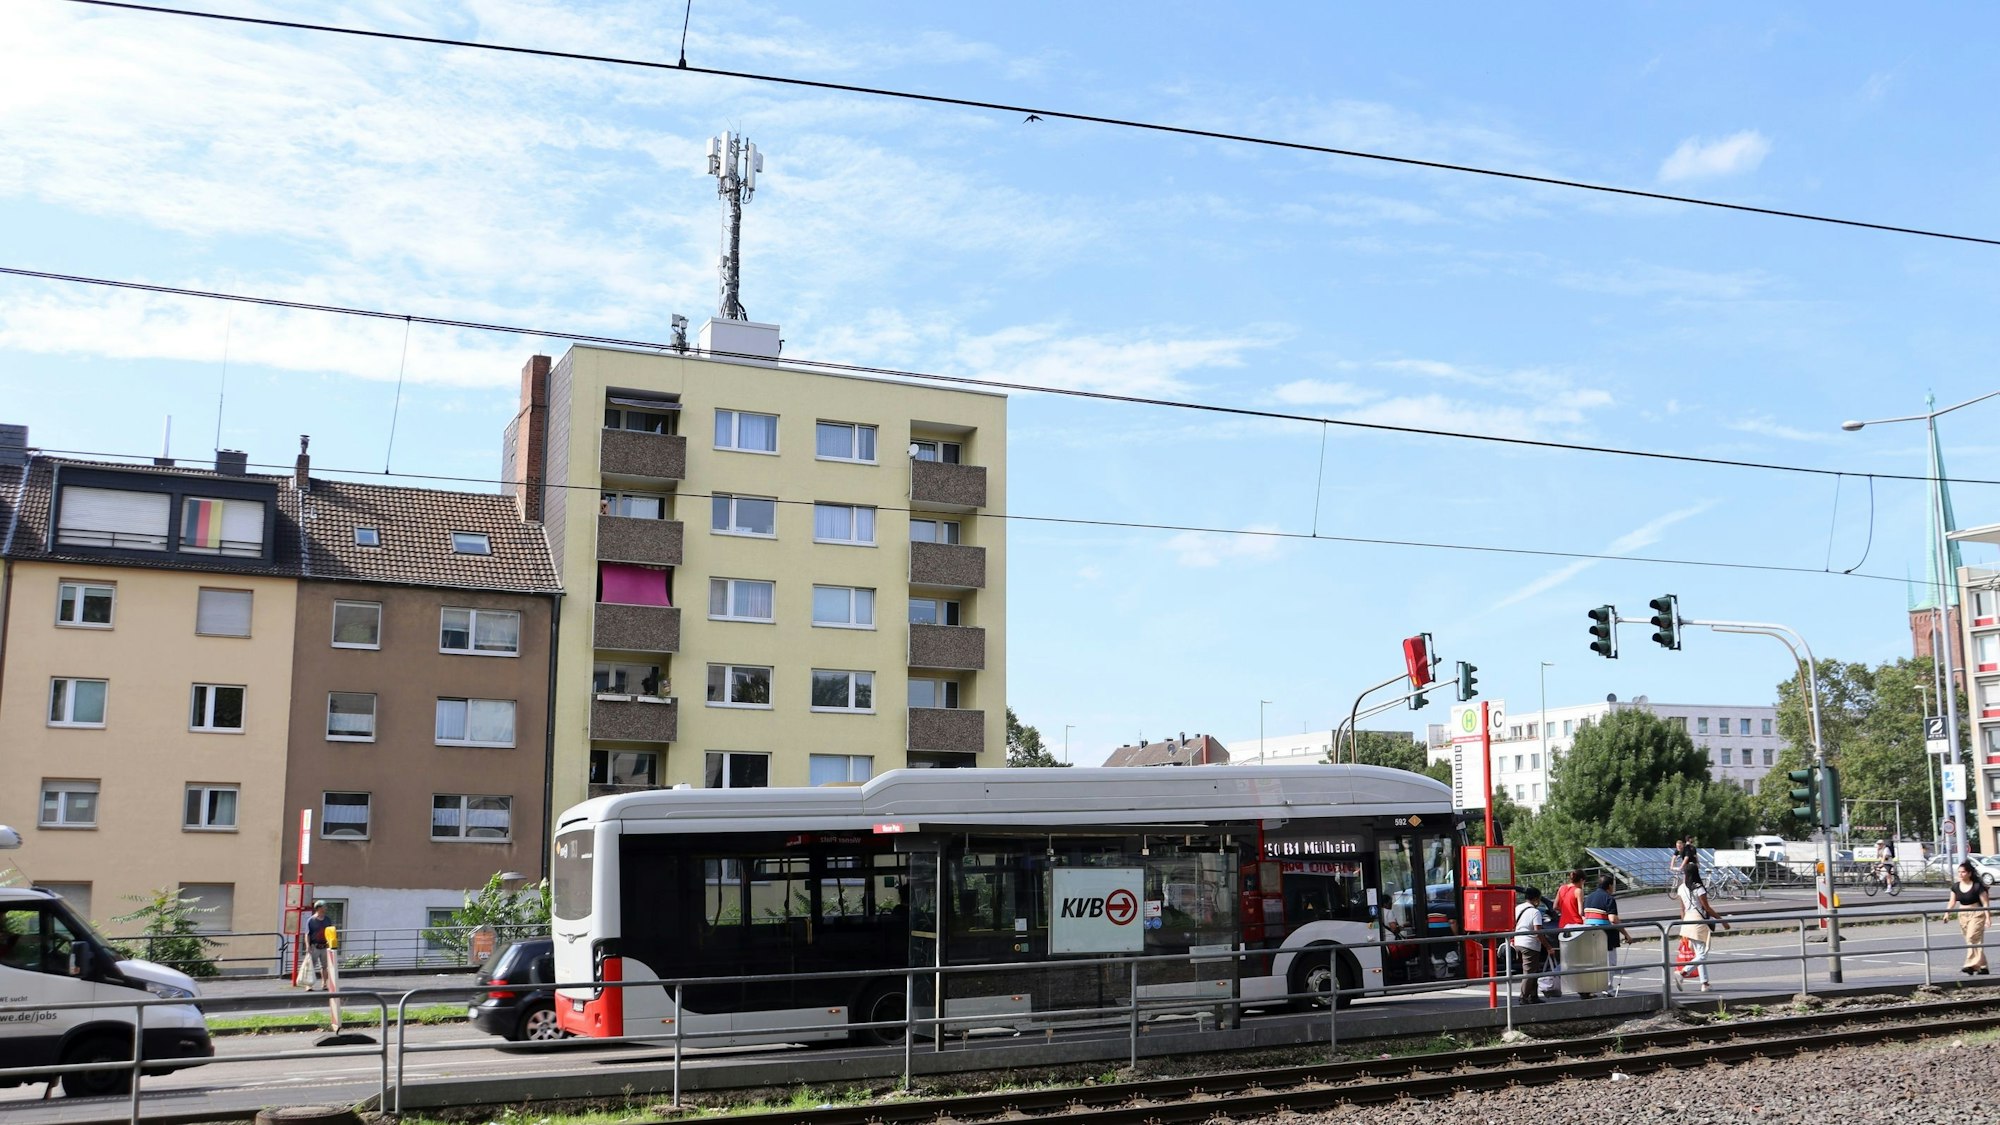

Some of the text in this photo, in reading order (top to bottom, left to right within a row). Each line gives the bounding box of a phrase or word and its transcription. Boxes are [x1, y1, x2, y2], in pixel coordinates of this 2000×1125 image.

[1493, 710, 1504, 729] C
[1394, 817, 1408, 827] 592
[1304, 840, 1356, 855] Mülheim
[1061, 897, 1105, 918] KVB
